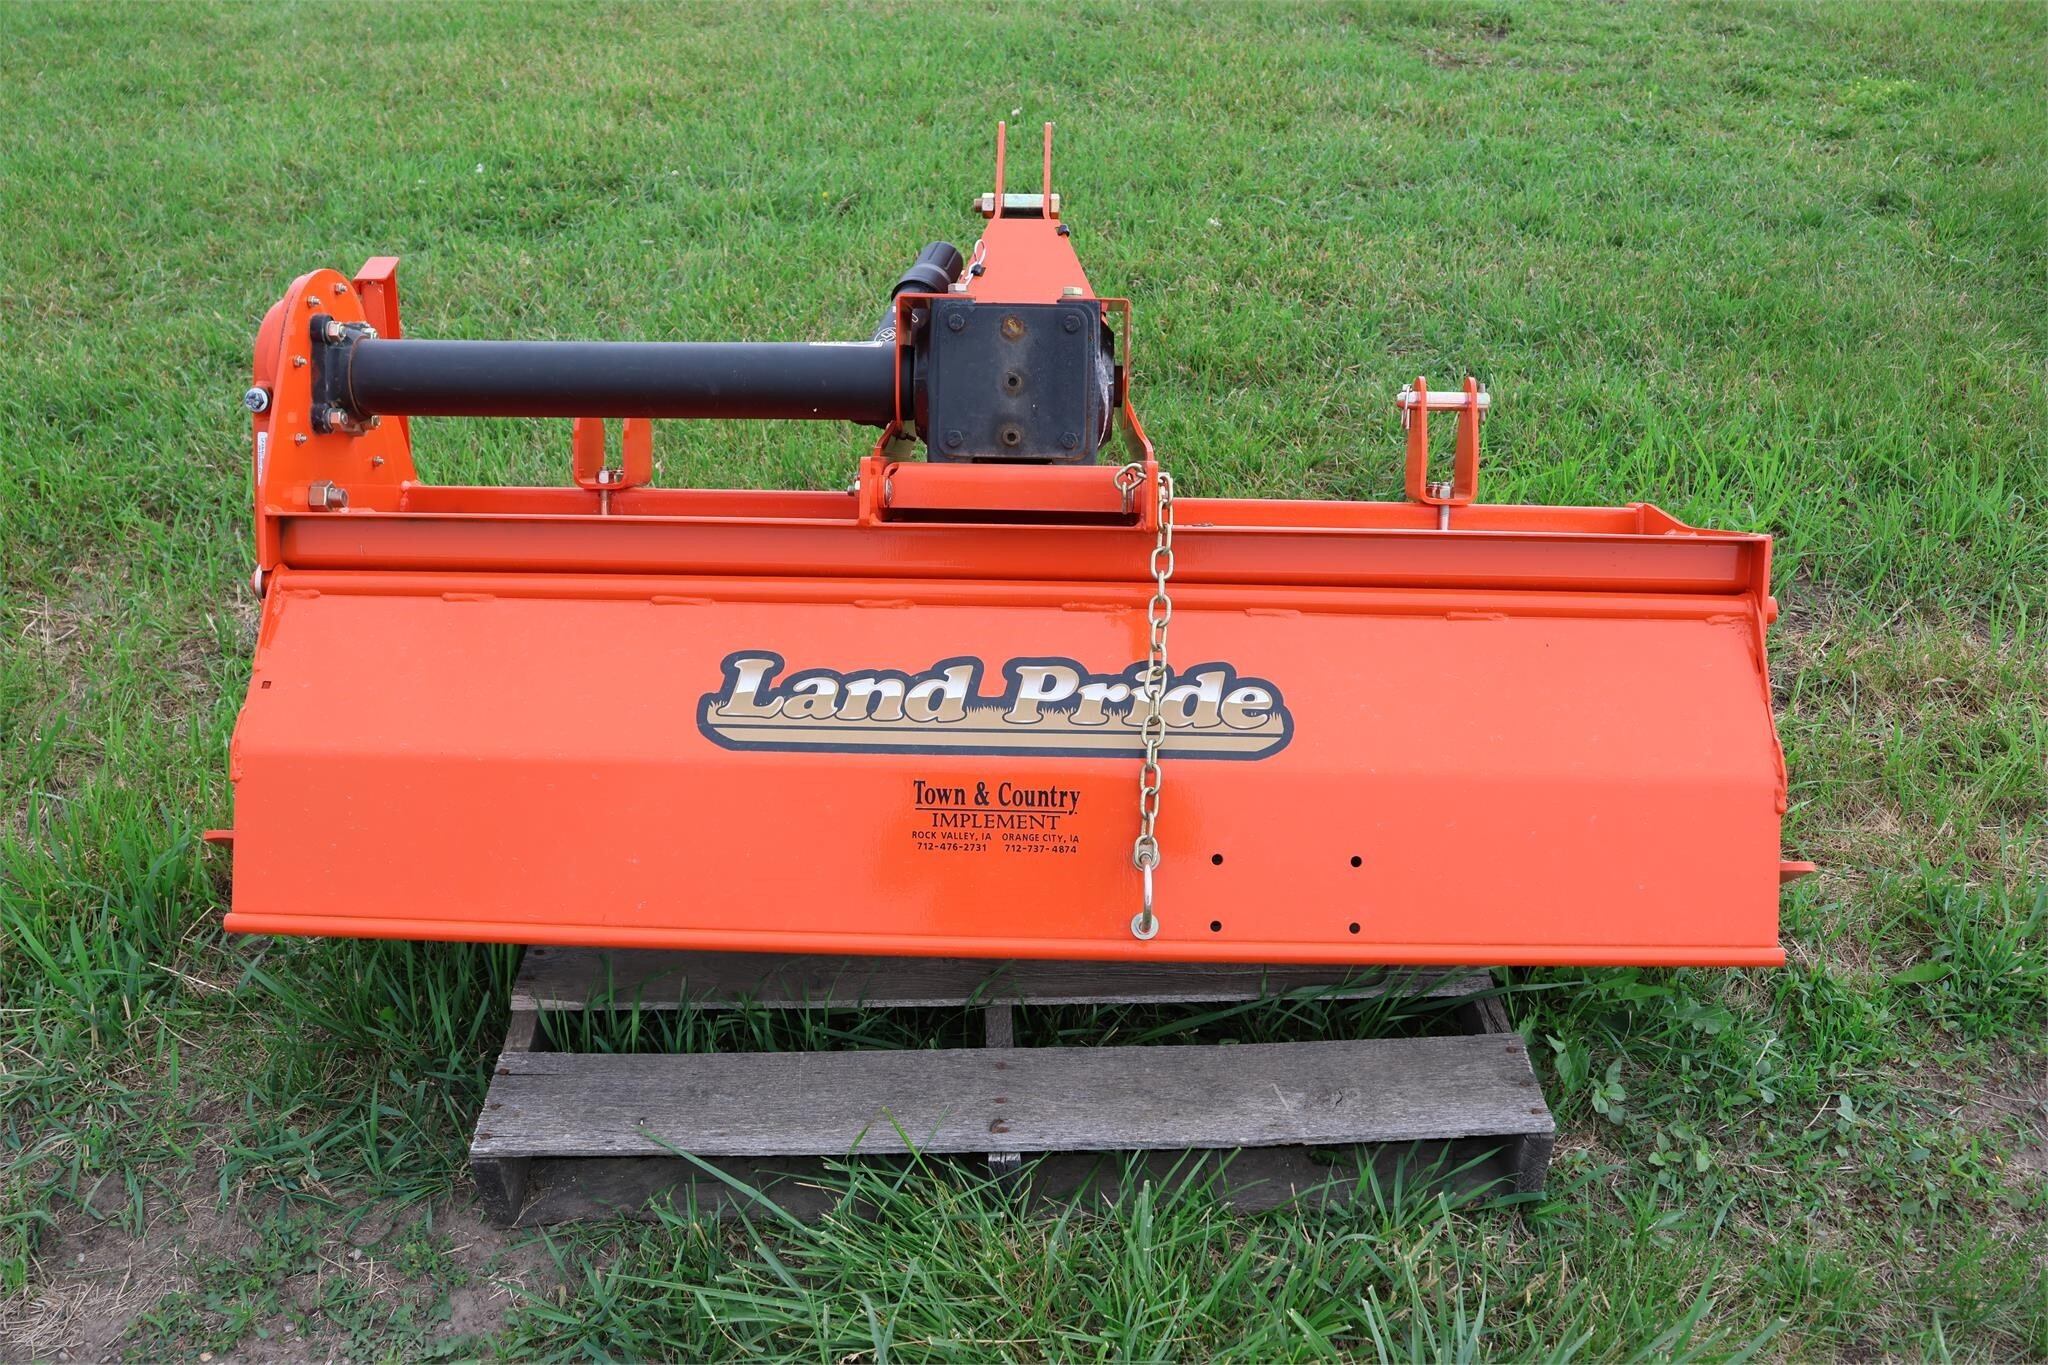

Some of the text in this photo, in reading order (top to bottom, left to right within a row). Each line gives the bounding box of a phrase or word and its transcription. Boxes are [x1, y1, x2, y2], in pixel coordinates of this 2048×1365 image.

[716, 658, 1273, 730] Land Pride
[913, 780, 1081, 815] Town & Country
[932, 812, 1061, 830] IMPLEMENT
[912, 831, 992, 841] ROCK VALLEY, IA
[1002, 833, 1079, 844] ORANGE CITY, IA
[917, 842, 987, 852] 712-476-2731
[1005, 844, 1077, 854] 712-737-4874
